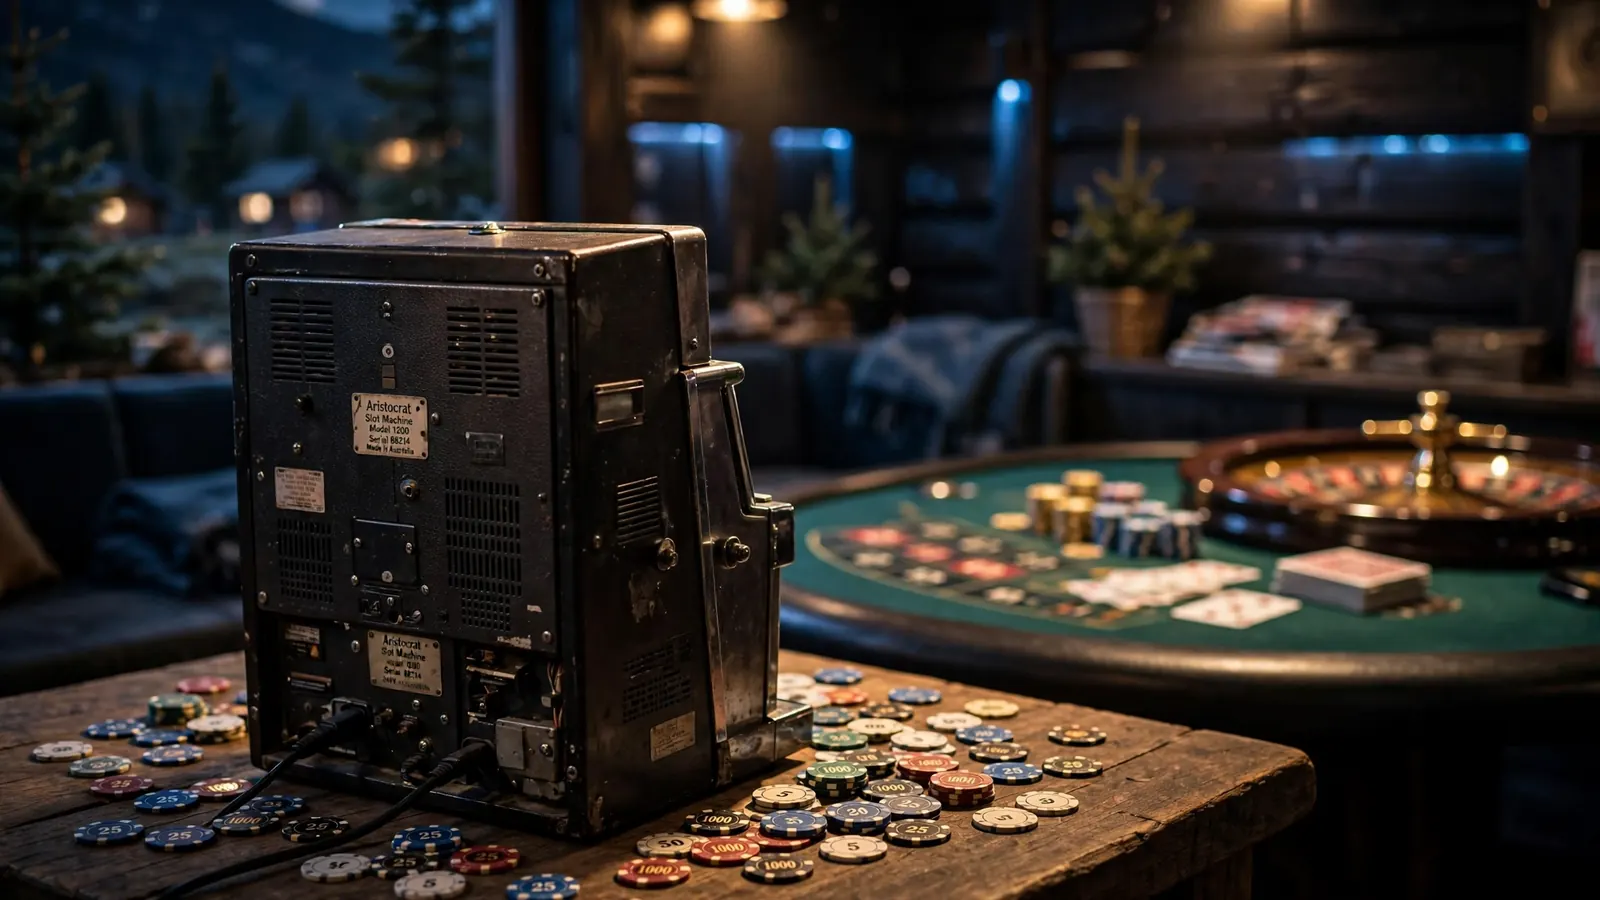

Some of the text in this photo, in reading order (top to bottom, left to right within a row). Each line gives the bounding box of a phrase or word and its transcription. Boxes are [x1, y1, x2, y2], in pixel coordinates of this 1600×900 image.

[366, 400, 412, 414] Aristocrat
[365, 413, 413, 425] Slot Machine
[369, 424, 410, 435] Model 1200
[382, 634, 421, 650] Aristocrat
[822, 765, 851, 774] 1000
[1002, 767, 1024, 775] 25
[876, 784, 905, 792] 1000
[156, 795, 178, 803] 25
[703, 815, 733, 824] 1000
[99, 826, 122, 834] 25
[905, 825, 930, 834] 25
[168, 831, 192, 841] 25
[419, 830, 441, 840] 25
[657, 839, 684, 848] 50
[710, 842, 744, 854] 1000
[847, 842, 860, 851] 5
[393, 857, 417, 867] 25
[764, 861, 797, 870] 1000
[638, 865, 673, 875] 1000
[423, 879, 436, 888] 5
[531, 881, 556, 893] 25
